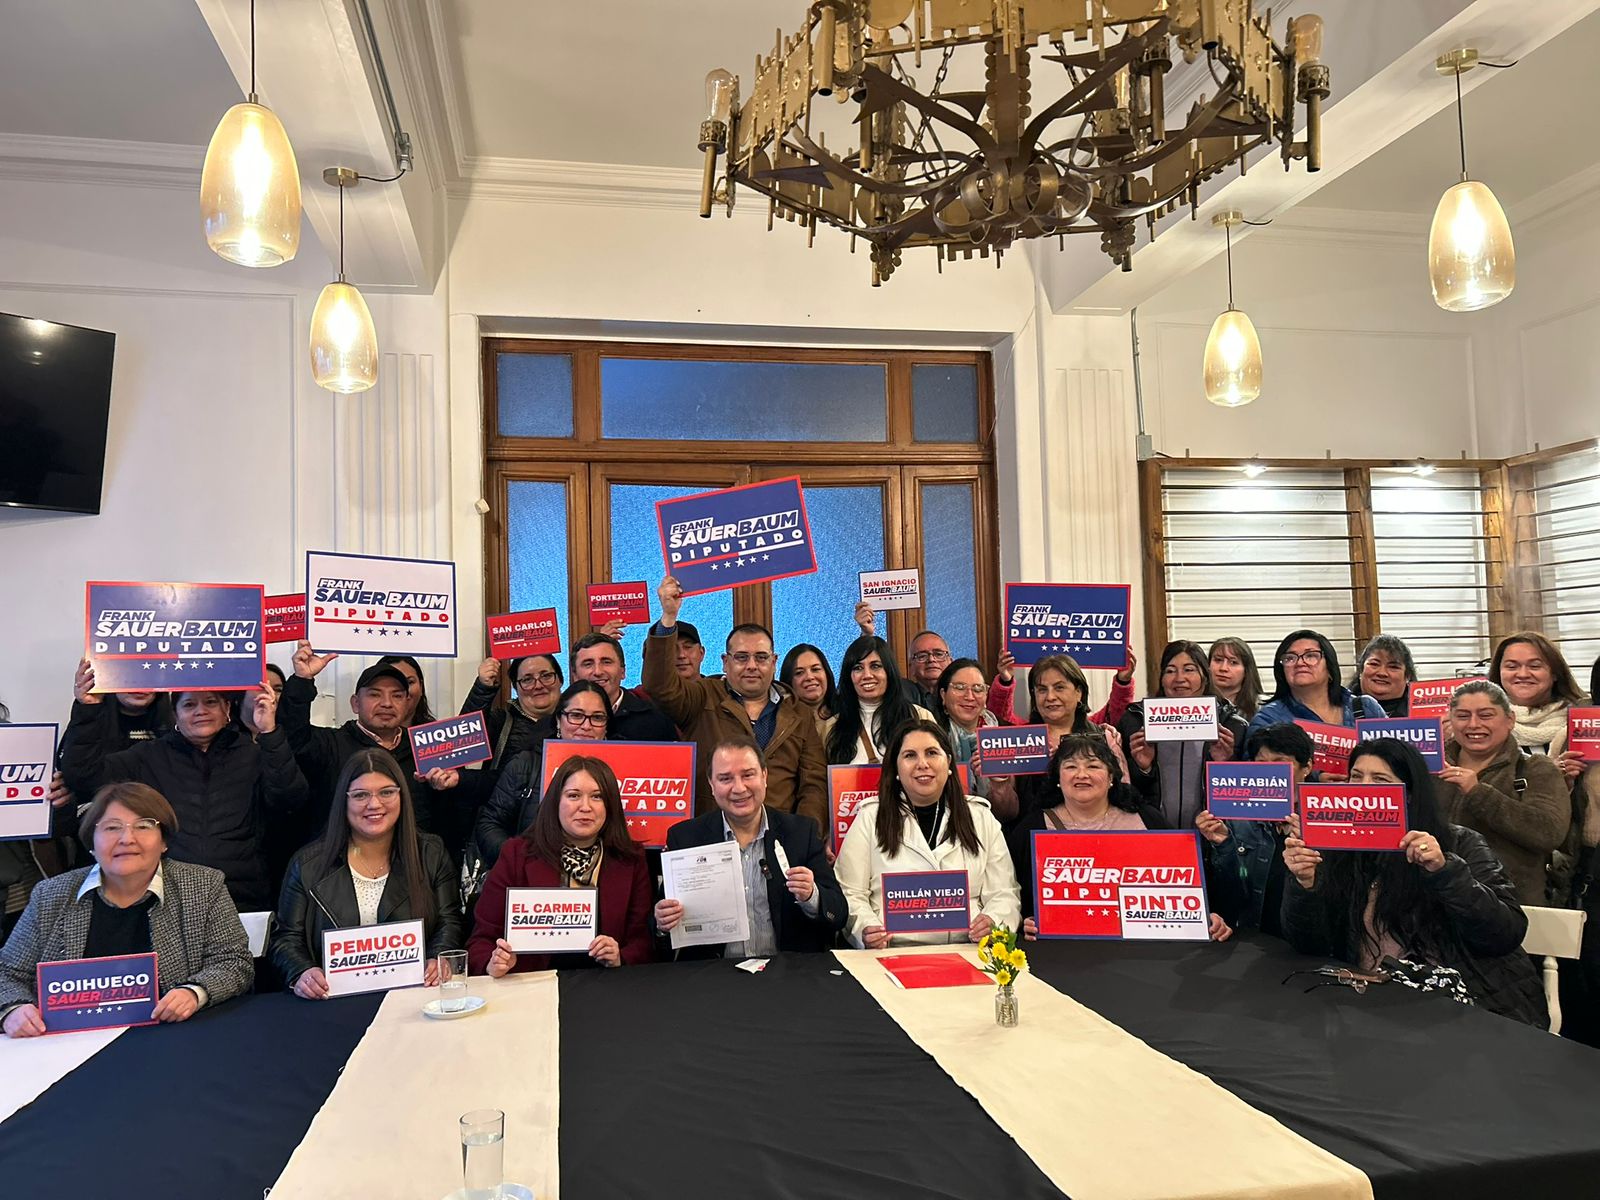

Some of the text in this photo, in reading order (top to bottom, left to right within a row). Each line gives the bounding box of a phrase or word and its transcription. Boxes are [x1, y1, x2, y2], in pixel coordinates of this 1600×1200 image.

[669, 510, 799, 548] SAUERBAUM
[671, 518, 712, 534] FRANK
[671, 529, 803, 562] DIPUTADO
[319, 578, 362, 590] FRANK
[881, 578, 917, 587] IGNACIO
[314, 588, 449, 610] SAUERBAUM
[590, 592, 645, 602] PORTEZUELO
[101, 611, 154, 621] FRANK
[314, 606, 449, 622] DIPUTADO
[1014, 605, 1050, 613] FRANK
[492, 620, 553, 635] SAN CARLOS
[1010, 612, 1124, 629] SAUERBAUM
[95, 620, 257, 638] SAUERBAUM
[1010, 629, 1124, 639] DIPUTADO
[95, 641, 258, 653] DIPUTADO
[1149, 704, 1211, 715] YUNGAY
[414, 719, 482, 747] ÑIQUÉN
[981, 733, 1046, 749] CHILLÁN
[1211, 775, 1288, 788] SAN FABIÁN
[1306, 796, 1399, 811] RANQUIL
[1306, 810, 1400, 823] SAUERBAUM
[1045, 858, 1093, 868] FRANK
[1041, 866, 1195, 886] SAUERBAUM
[886, 887, 965, 899] CHILLÁN VIEJO
[1042, 887, 1111, 899] DIPU
[511, 903, 591, 914] EL CARMEN
[1123, 895, 1201, 911] PINTO
[511, 914, 592, 926] SAUERBAUM
[1125, 910, 1202, 920] SAUERBAUM
[329, 933, 417, 956] PEMUCO
[328, 947, 419, 969] SAUERBAUM
[48, 973, 150, 994] COIHUECO
